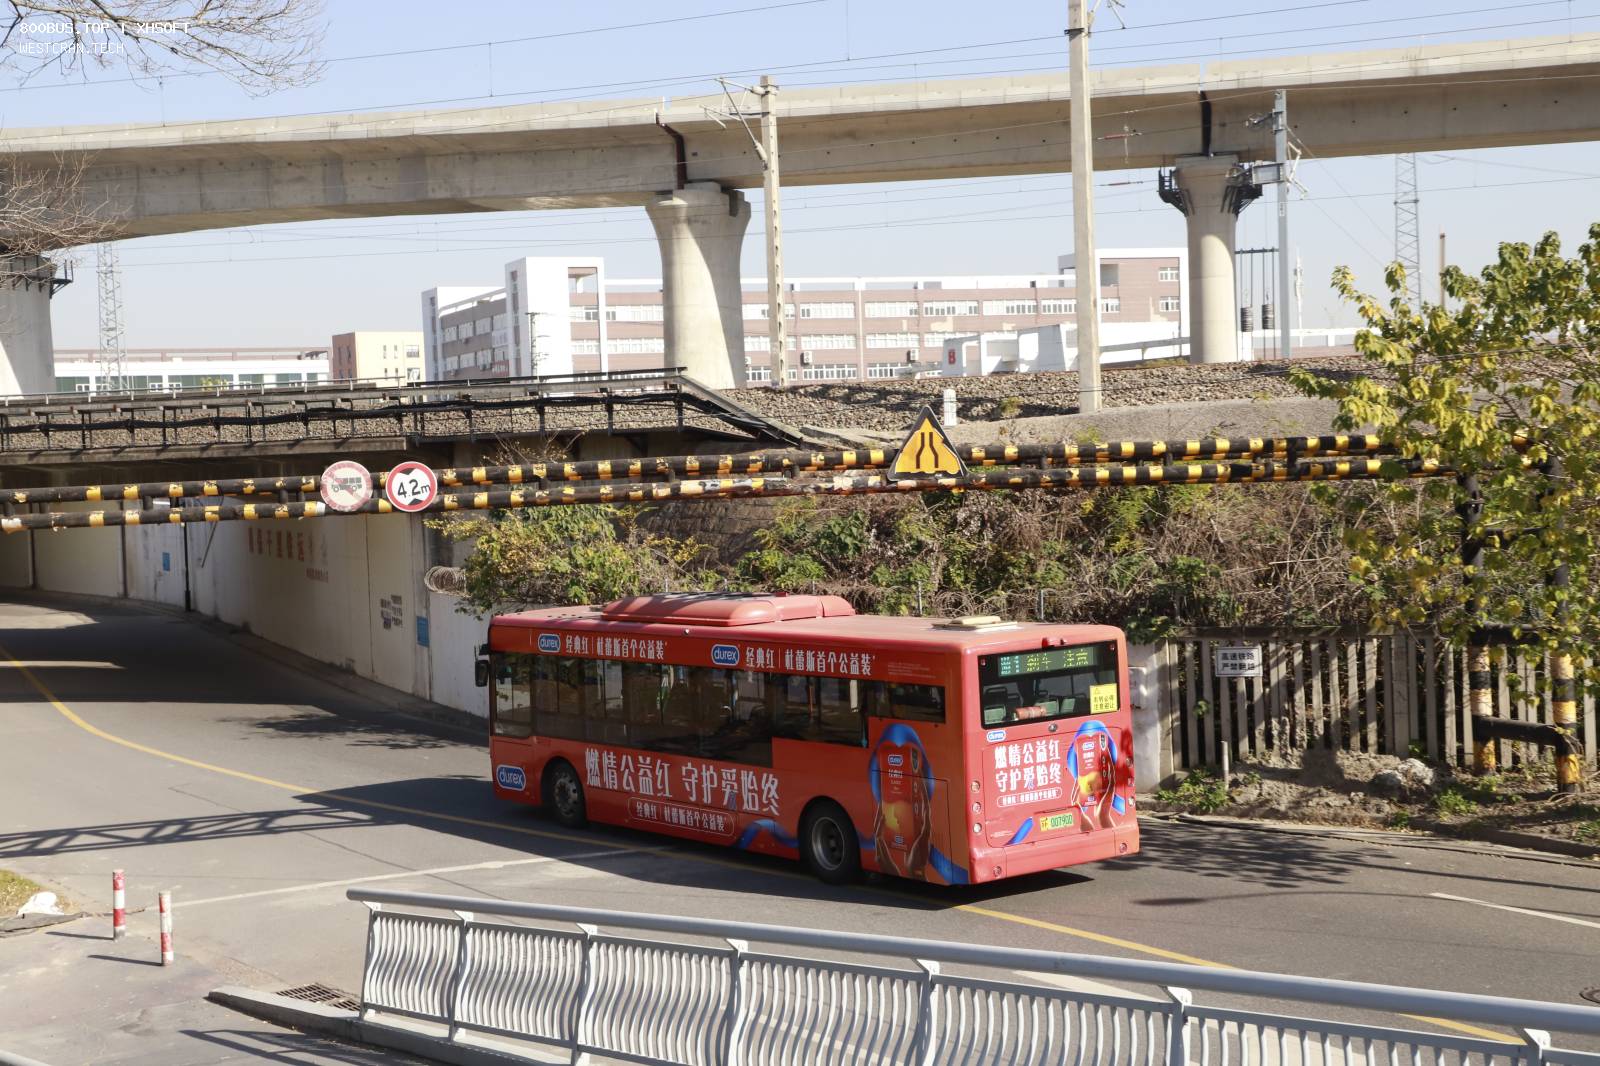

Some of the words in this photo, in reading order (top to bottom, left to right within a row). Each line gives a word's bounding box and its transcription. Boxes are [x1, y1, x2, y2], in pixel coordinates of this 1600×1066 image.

[540, 638, 559, 649] durex
[565, 635, 589, 655] 经典红
[713, 648, 738, 662] durex
[745, 646, 775, 669] 经典红
[784, 648, 872, 676] 杜蕾斯首个公益装
[994, 739, 1060, 769] 燃情公益红
[500, 768, 523, 788] durex
[584, 747, 673, 798] 燃情公益红
[681, 762, 780, 816] 守护爱始终
[995, 763, 1061, 792] 守护爱始终
